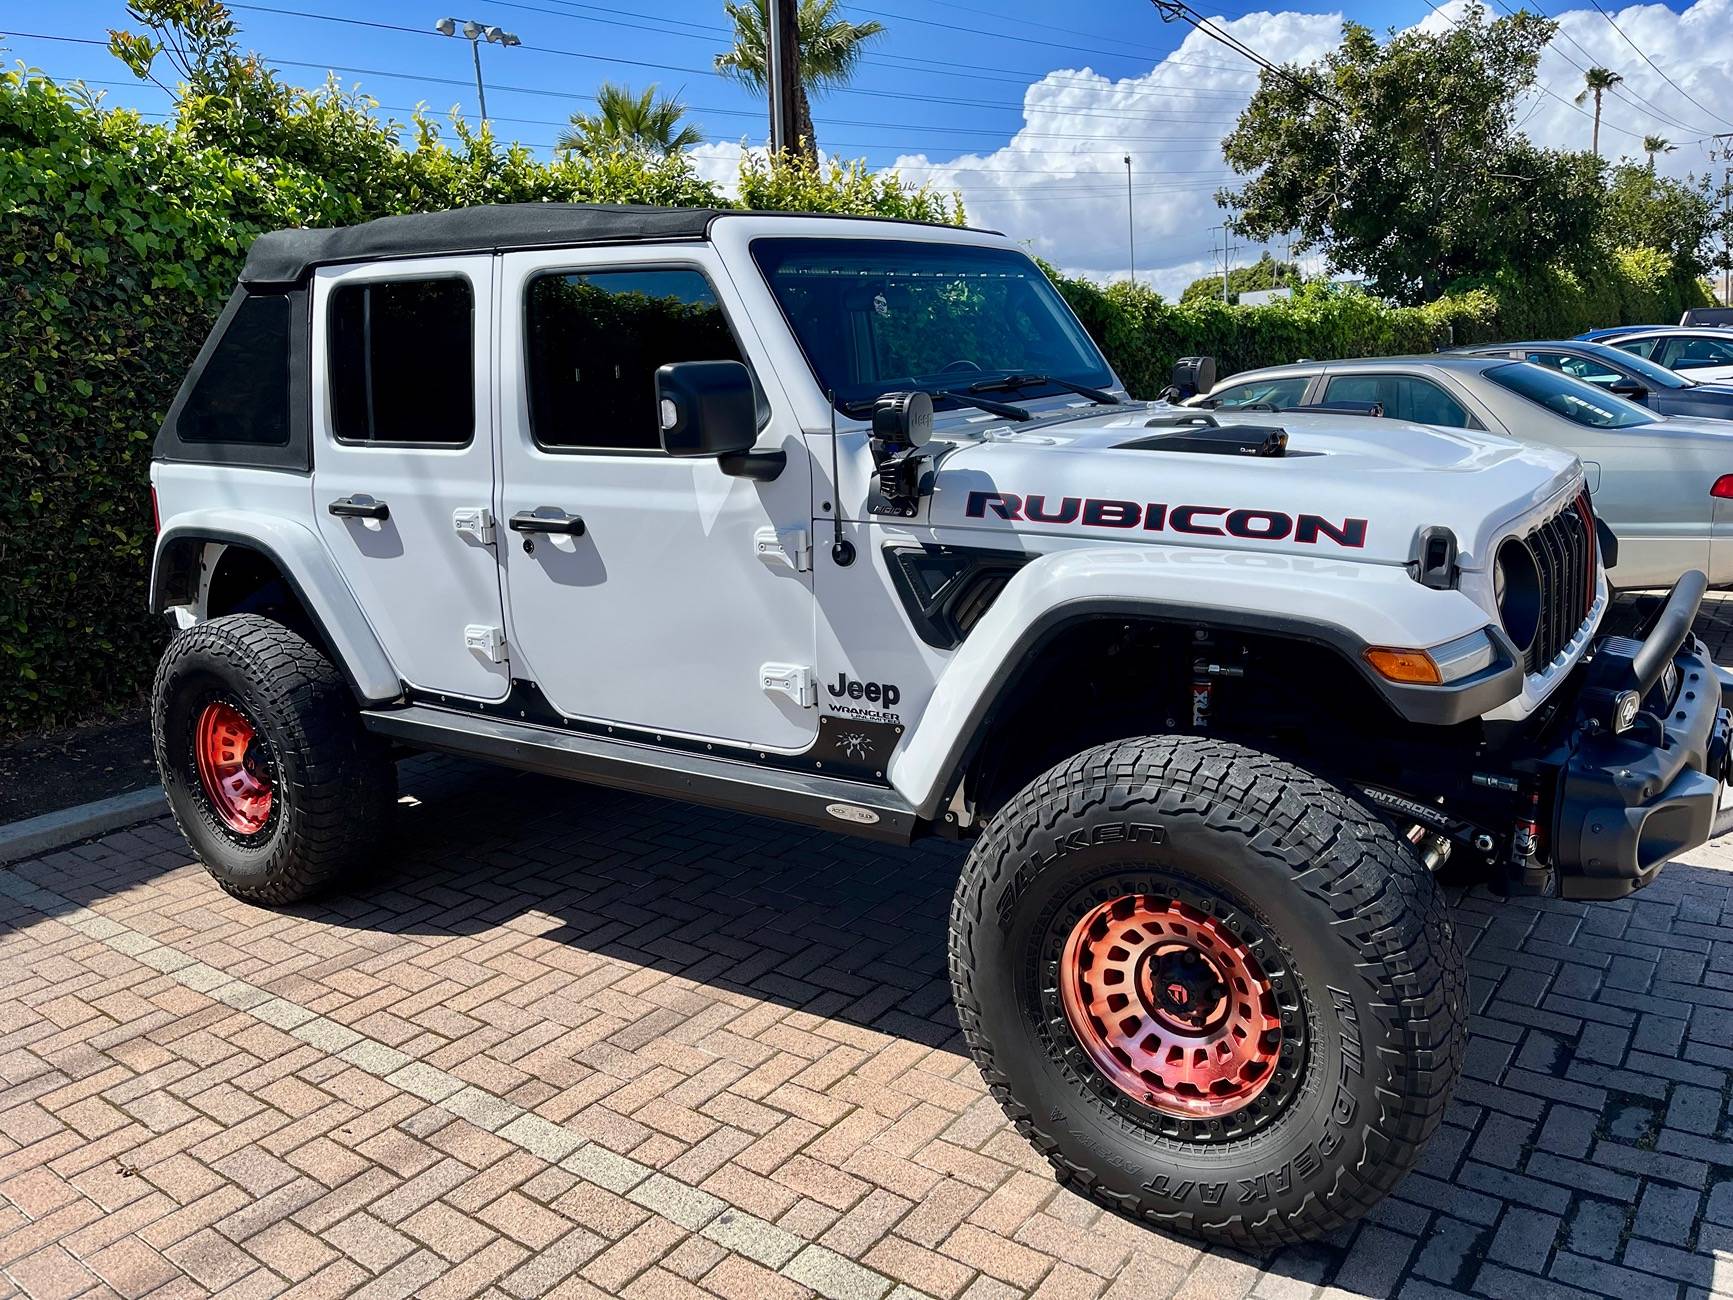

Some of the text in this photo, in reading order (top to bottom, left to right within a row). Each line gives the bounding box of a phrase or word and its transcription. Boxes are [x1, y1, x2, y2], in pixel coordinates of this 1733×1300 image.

[965, 490, 1368, 549] RUBICON
[827, 672, 901, 710] Jeep
[828, 703, 901, 721] WRANGLER
[996, 821, 1168, 922] FALKEN
[1237, 984, 1363, 1203] WILDPEAK
[1142, 1173, 1228, 1205] A/T
